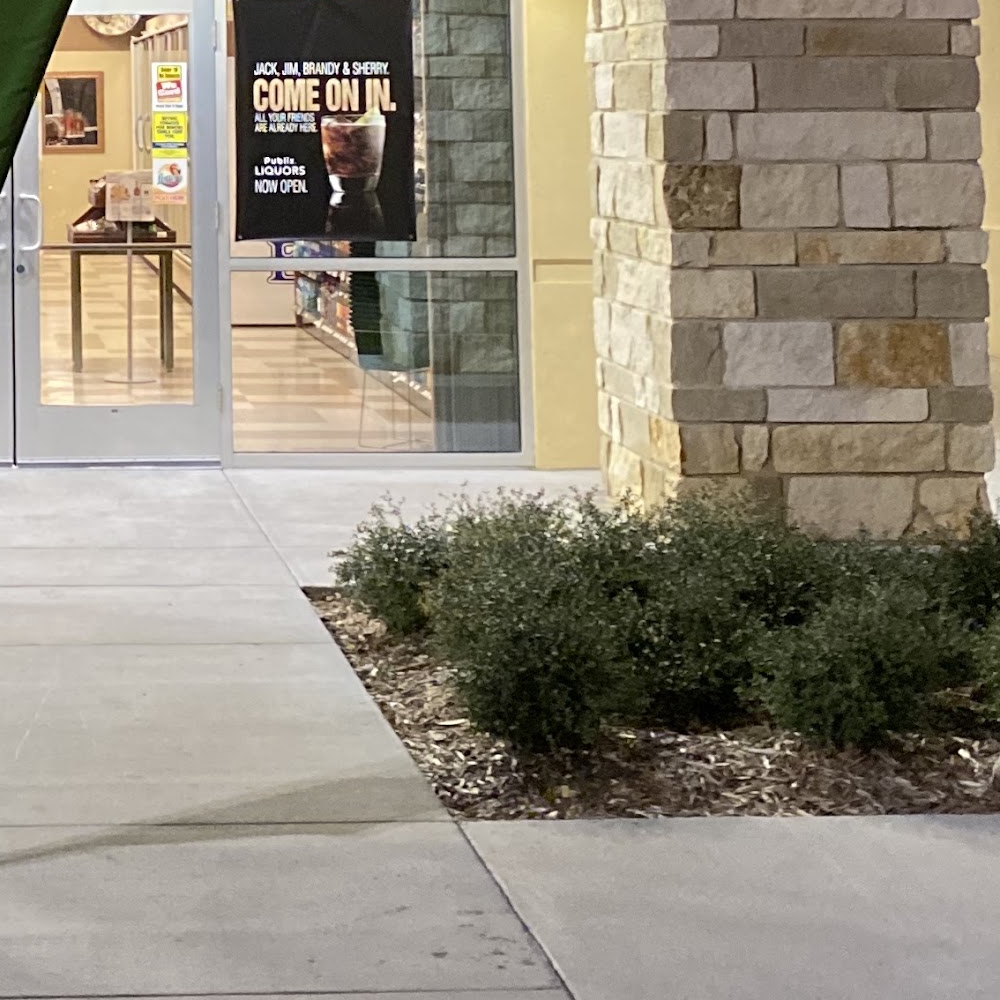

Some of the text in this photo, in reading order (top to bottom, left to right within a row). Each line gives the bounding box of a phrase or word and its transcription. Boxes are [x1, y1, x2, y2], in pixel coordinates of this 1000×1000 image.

[253, 61, 391, 77] JACK, JIM, BRANDY & SHERRY.
[252, 77, 397, 112] COME ON IN.
[254, 112, 315, 123] ALL YOUR FRIENDS
[254, 122, 268, 133] ARE
[268, 122, 299, 133] ALREADY
[254, 165, 306, 176] LIQUORS
[254, 179, 309, 194] NOW OPEN.
